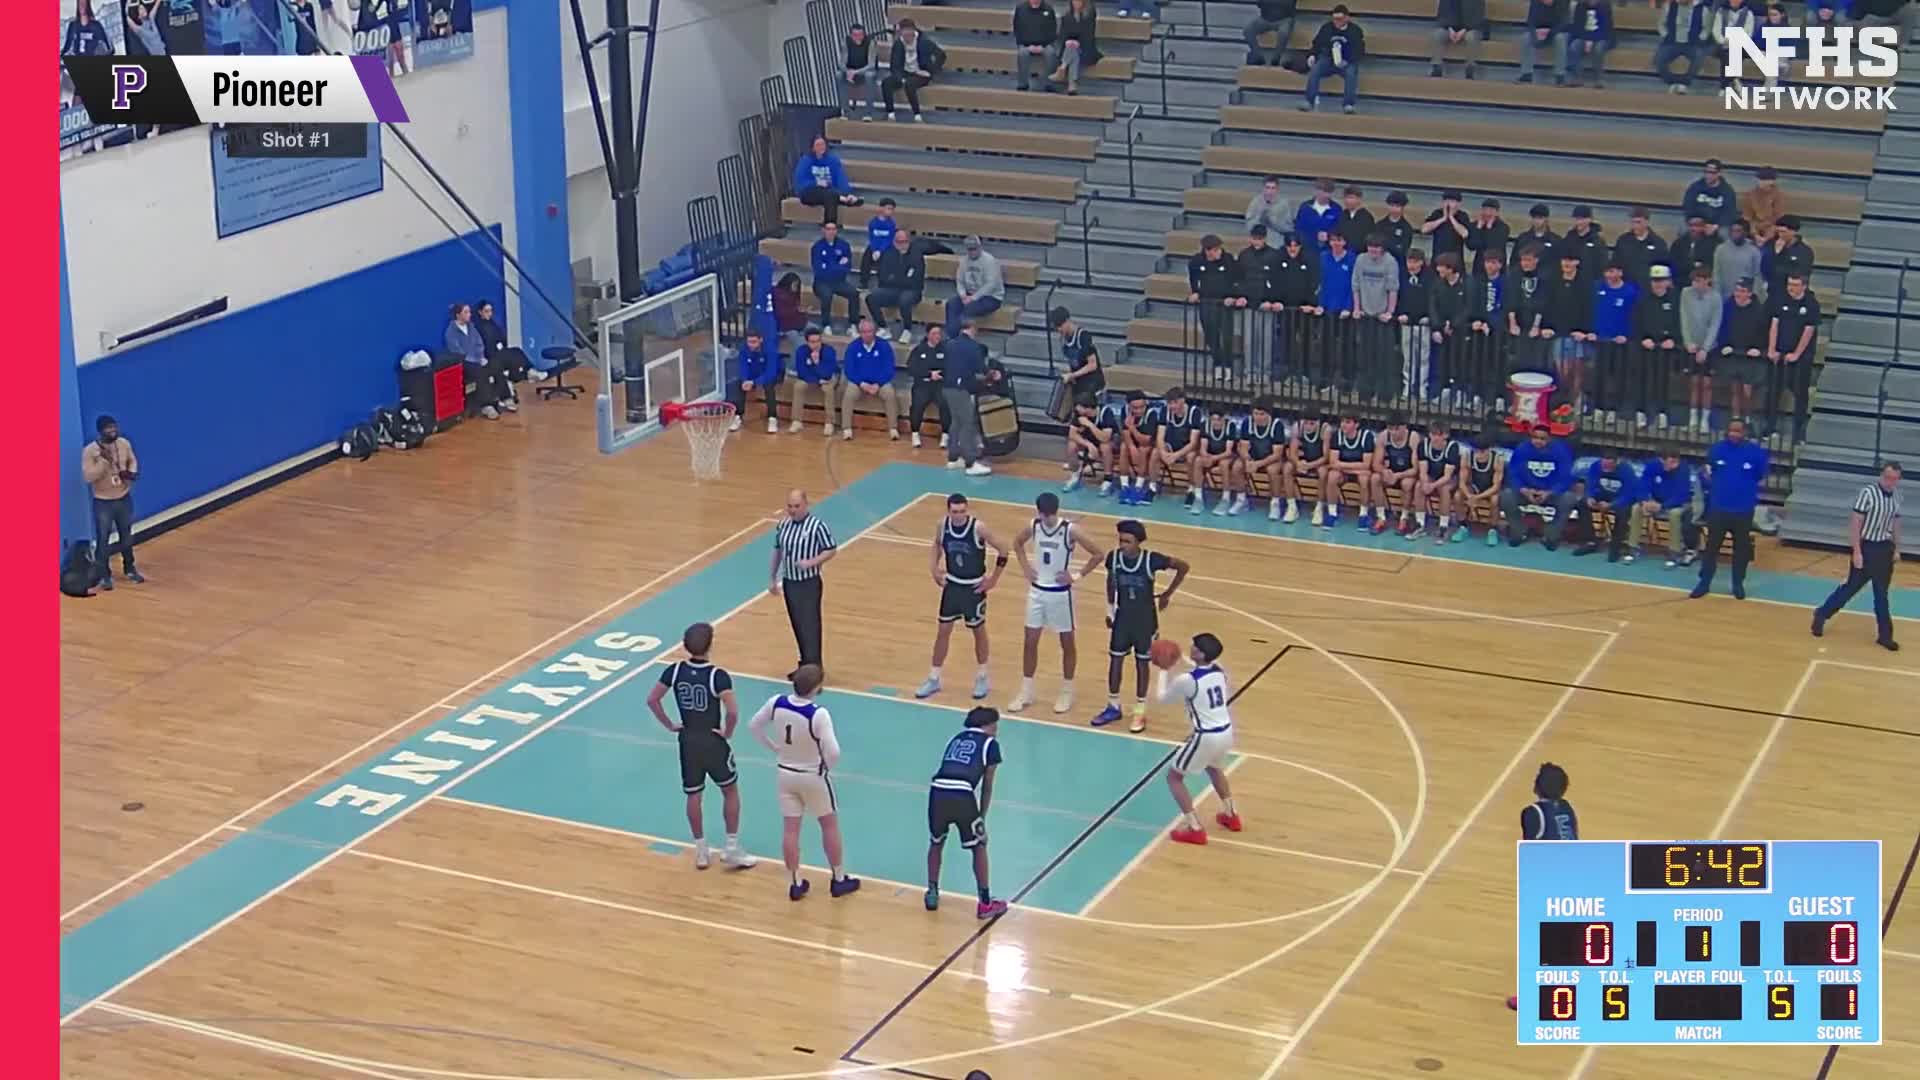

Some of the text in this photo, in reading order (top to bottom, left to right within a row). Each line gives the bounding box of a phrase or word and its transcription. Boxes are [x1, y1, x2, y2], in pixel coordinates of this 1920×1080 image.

[677, 682, 708, 712] 20
[1207, 686, 1224, 709] 13
[315, 631, 662, 816] SKYLINE
[784, 724, 792, 744] 1
[945, 739, 977, 764] 12
